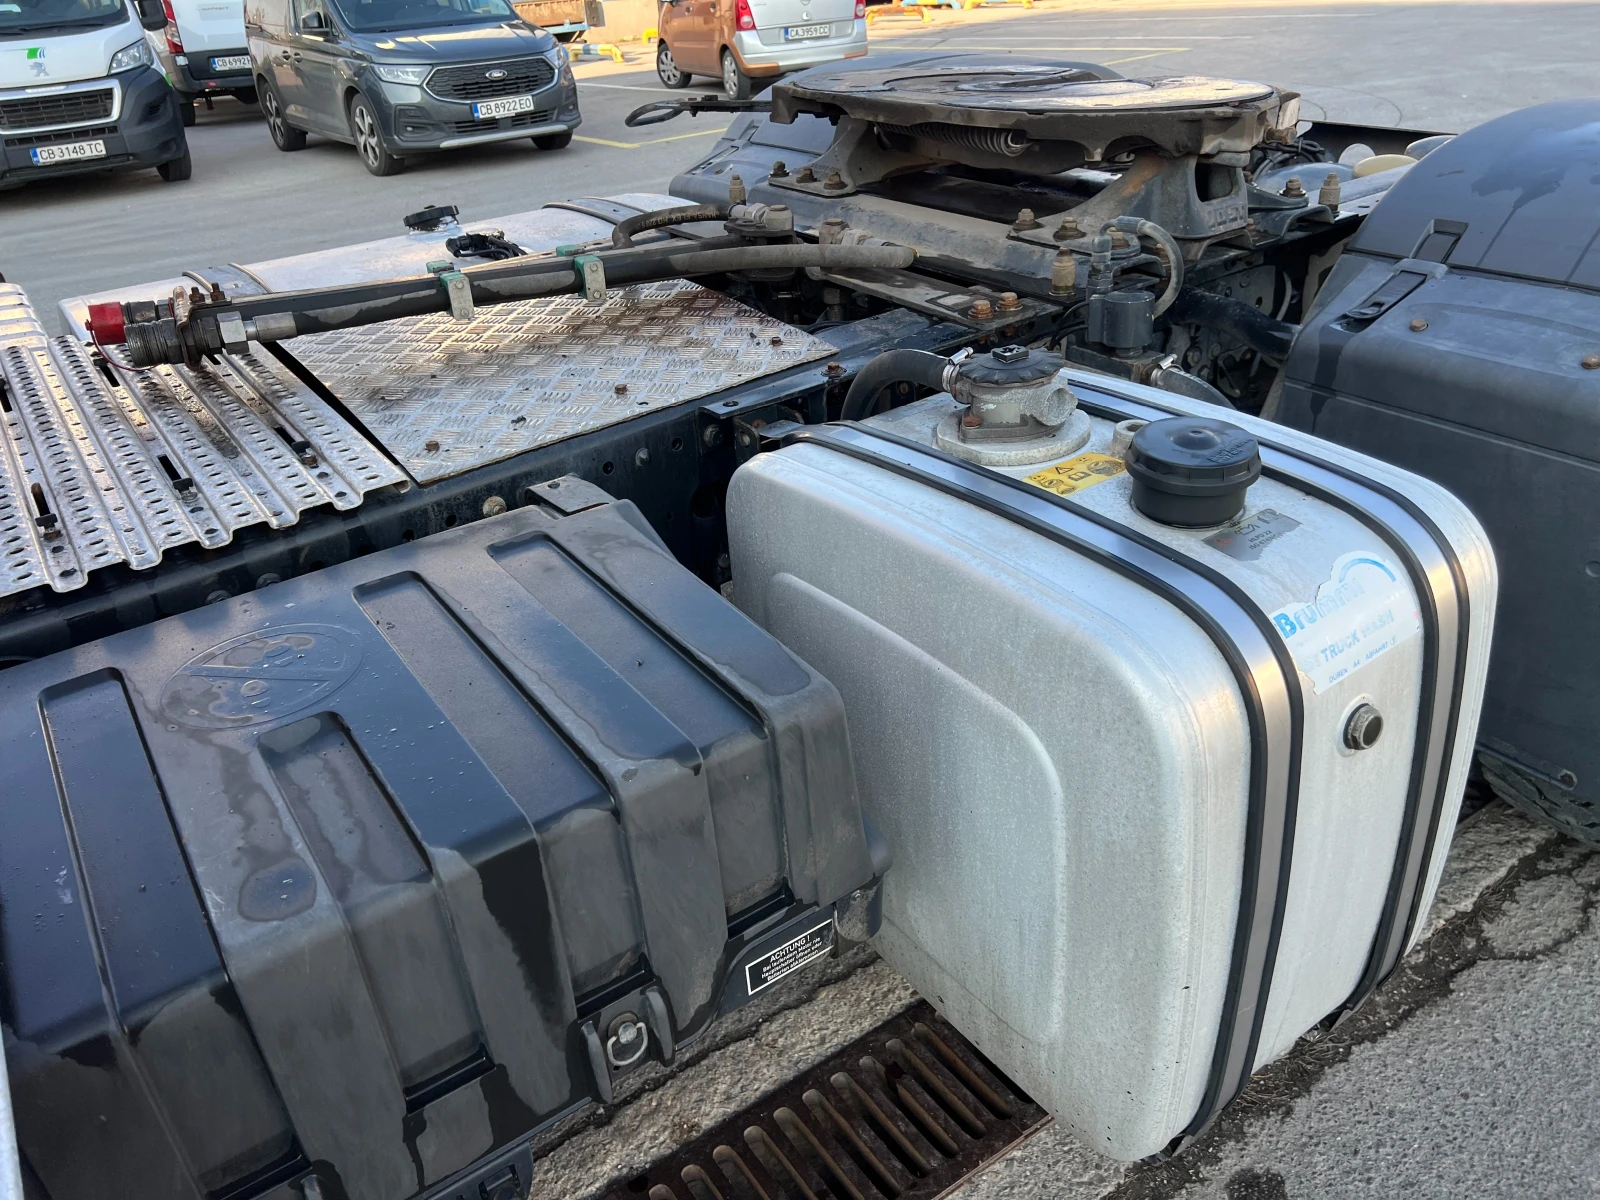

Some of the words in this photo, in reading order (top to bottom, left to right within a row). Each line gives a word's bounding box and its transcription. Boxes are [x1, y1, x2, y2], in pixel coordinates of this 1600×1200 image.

[790, 28, 801, 38] CA
[800, 26, 818, 37] 3959
[217, 58, 228, 67] CB
[228, 56, 247, 66] 6992
[479, 103, 493, 116] CB
[494, 100, 518, 114] 8922
[39, 148, 56, 160] CB
[57, 144, 86, 158] 3148
[86, 142, 103, 154] TC
[1320, 629, 1361, 662] TRUCK
[1365, 641, 1388, 660] ABFAHRT
[770, 937, 806, 962] ACHTUNG
